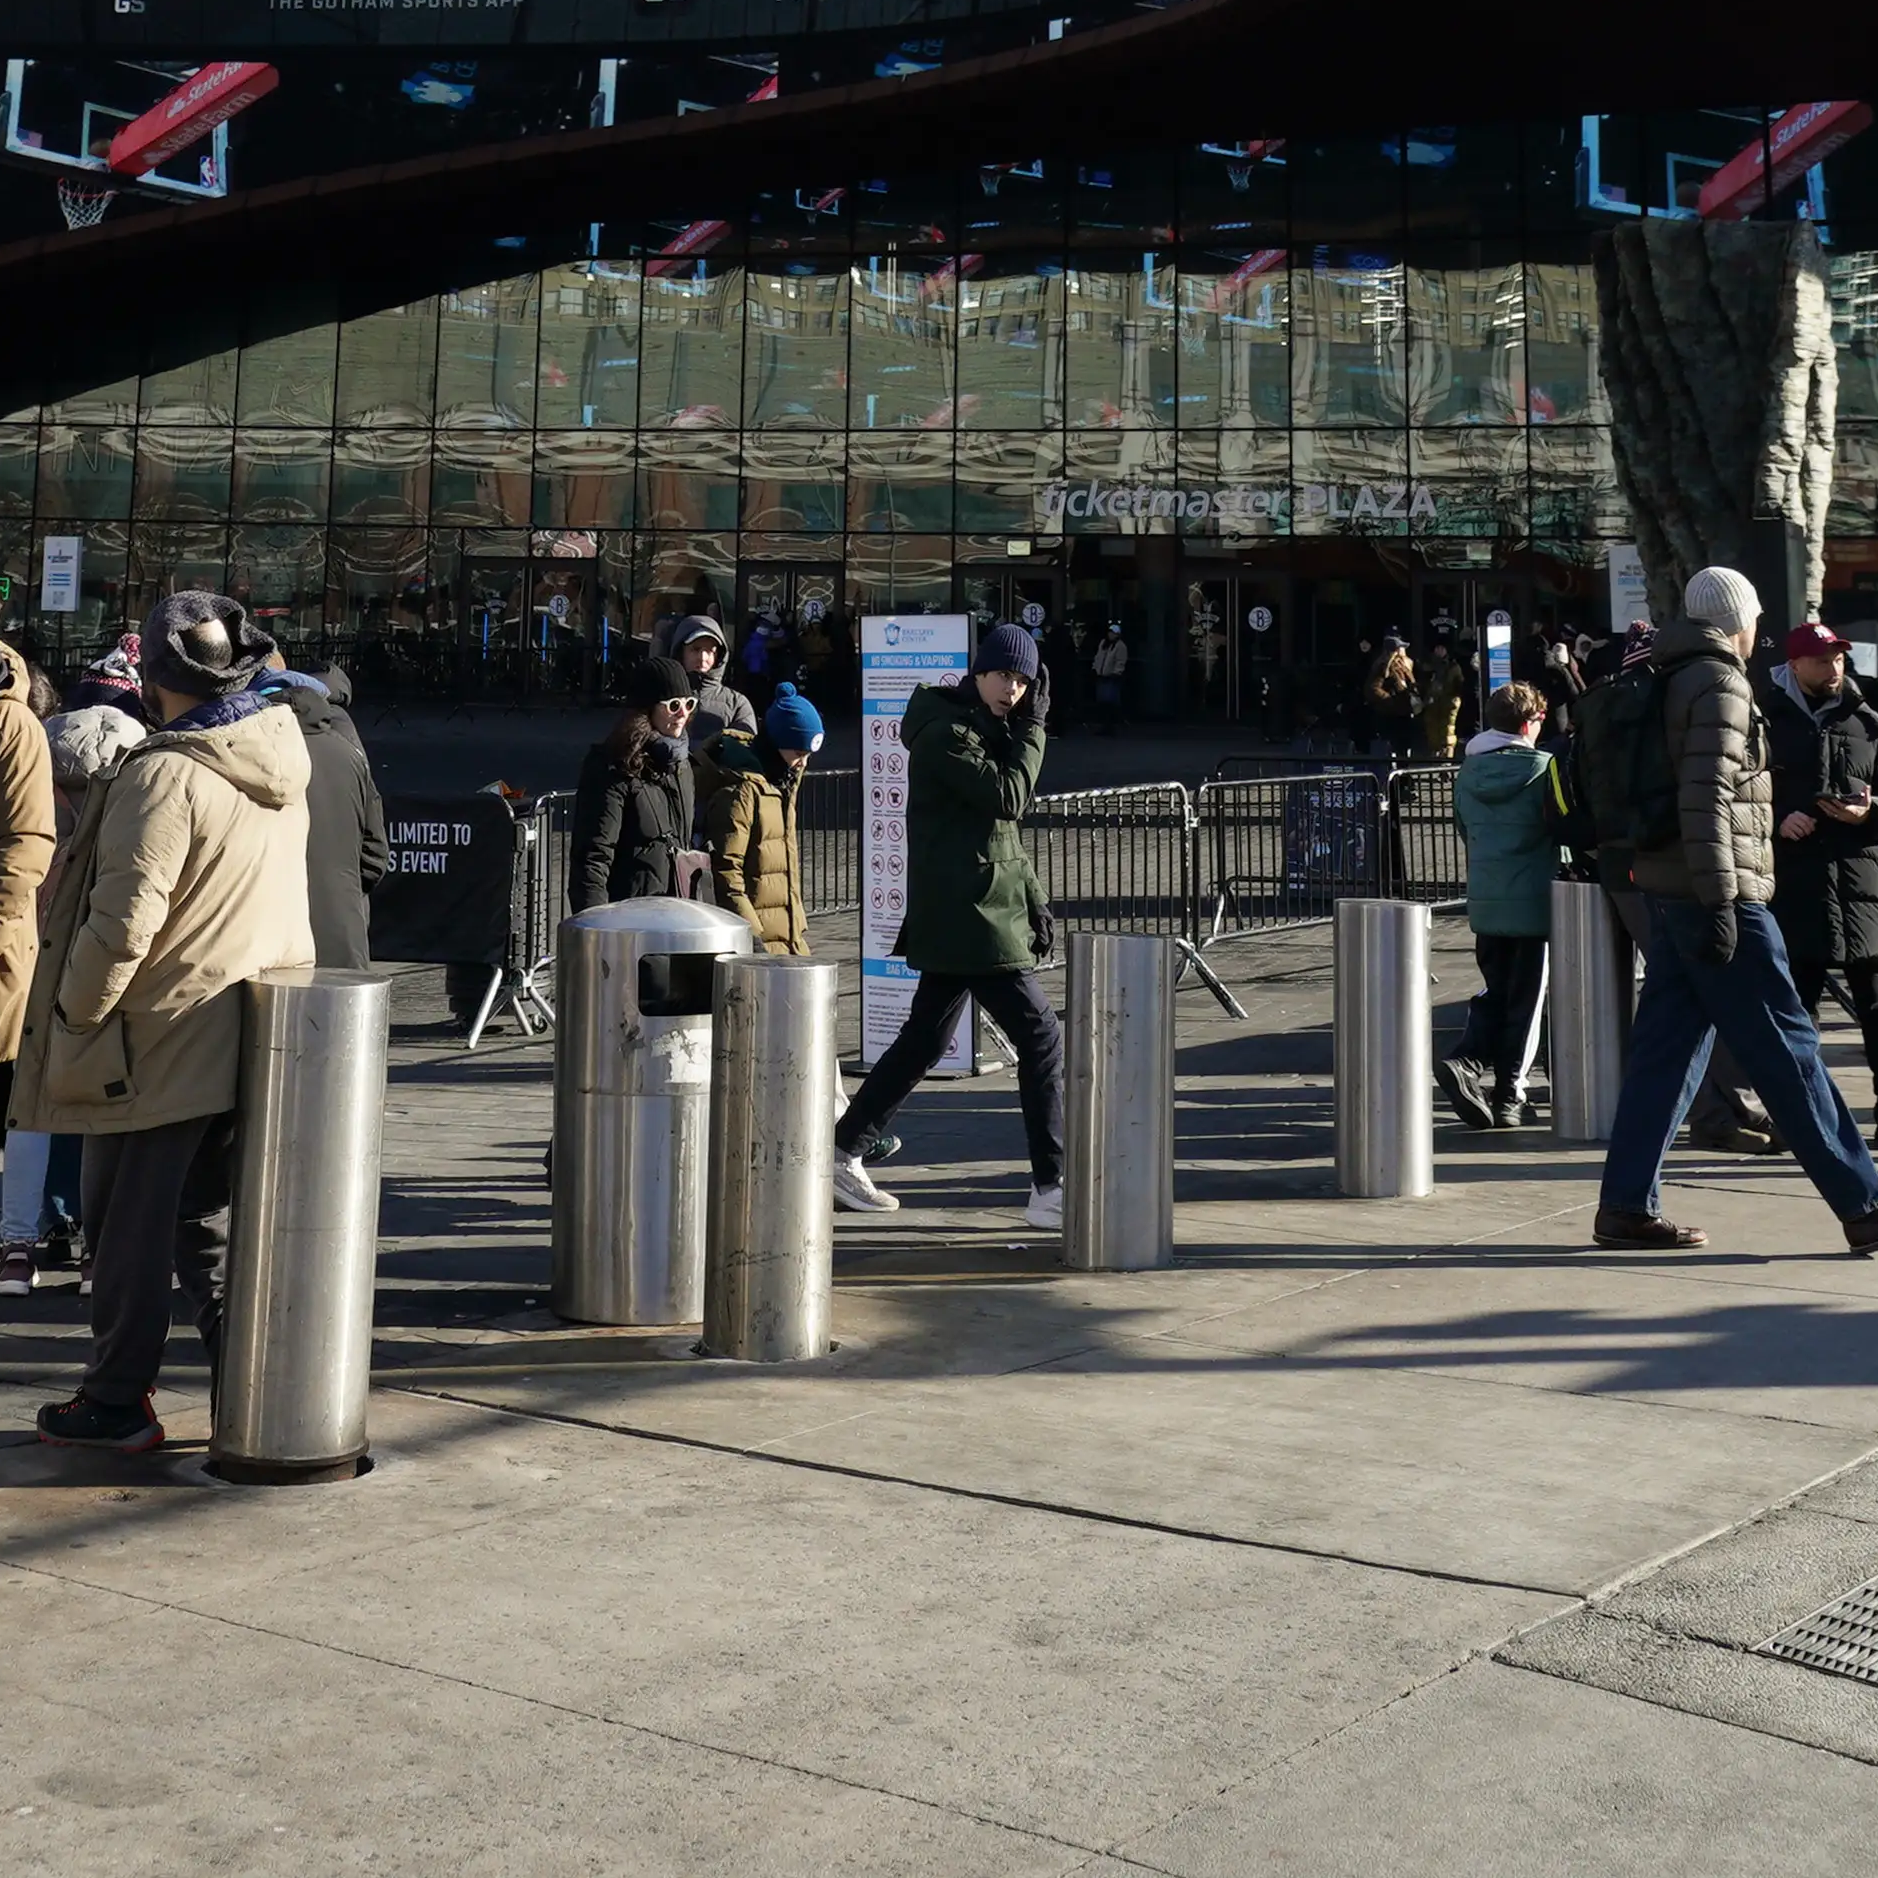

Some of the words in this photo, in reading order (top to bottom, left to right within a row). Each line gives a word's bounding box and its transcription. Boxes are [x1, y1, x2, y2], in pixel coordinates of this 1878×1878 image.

[1042, 480, 1290, 518] ticketmaster
[1306, 481, 1437, 518] PLAZA
[914, 655, 920, 666] &
[921, 654, 954, 667] VAPING
[389, 822, 448, 845] LIMITED
[452, 823, 471, 845] TO
[401, 851, 449, 874] EVENT
[885, 962, 901, 975] BAG
